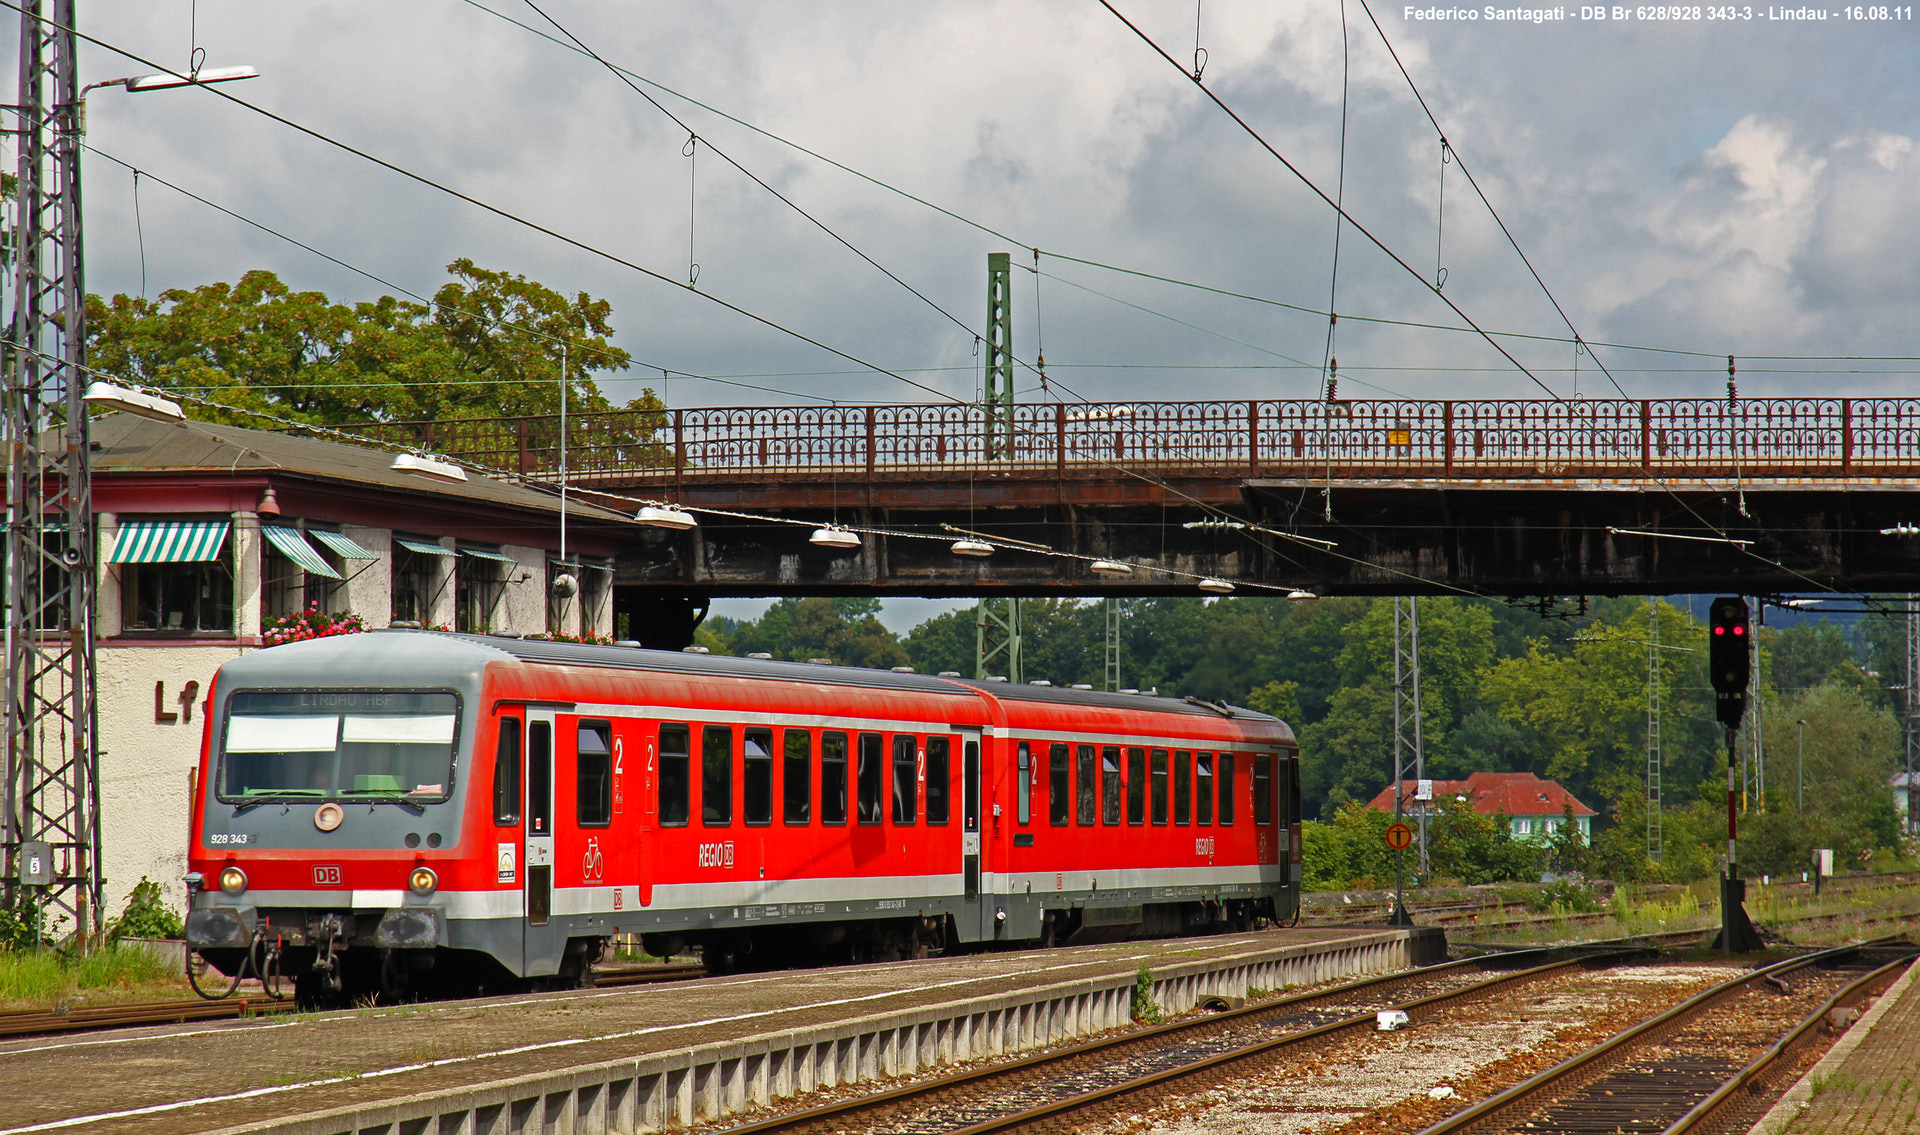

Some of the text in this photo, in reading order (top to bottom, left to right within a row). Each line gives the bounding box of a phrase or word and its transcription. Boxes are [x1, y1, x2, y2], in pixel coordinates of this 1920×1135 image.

[301, 694, 393, 706] LINDAU HBF
[615, 738, 623, 775] 2
[647, 743, 654, 771] 2
[918, 750, 925, 781] 2
[1032, 755, 1037, 785] 2
[211, 834, 229, 844] 928
[699, 843, 723, 867] REGIO
[314, 866, 341, 884] DB
